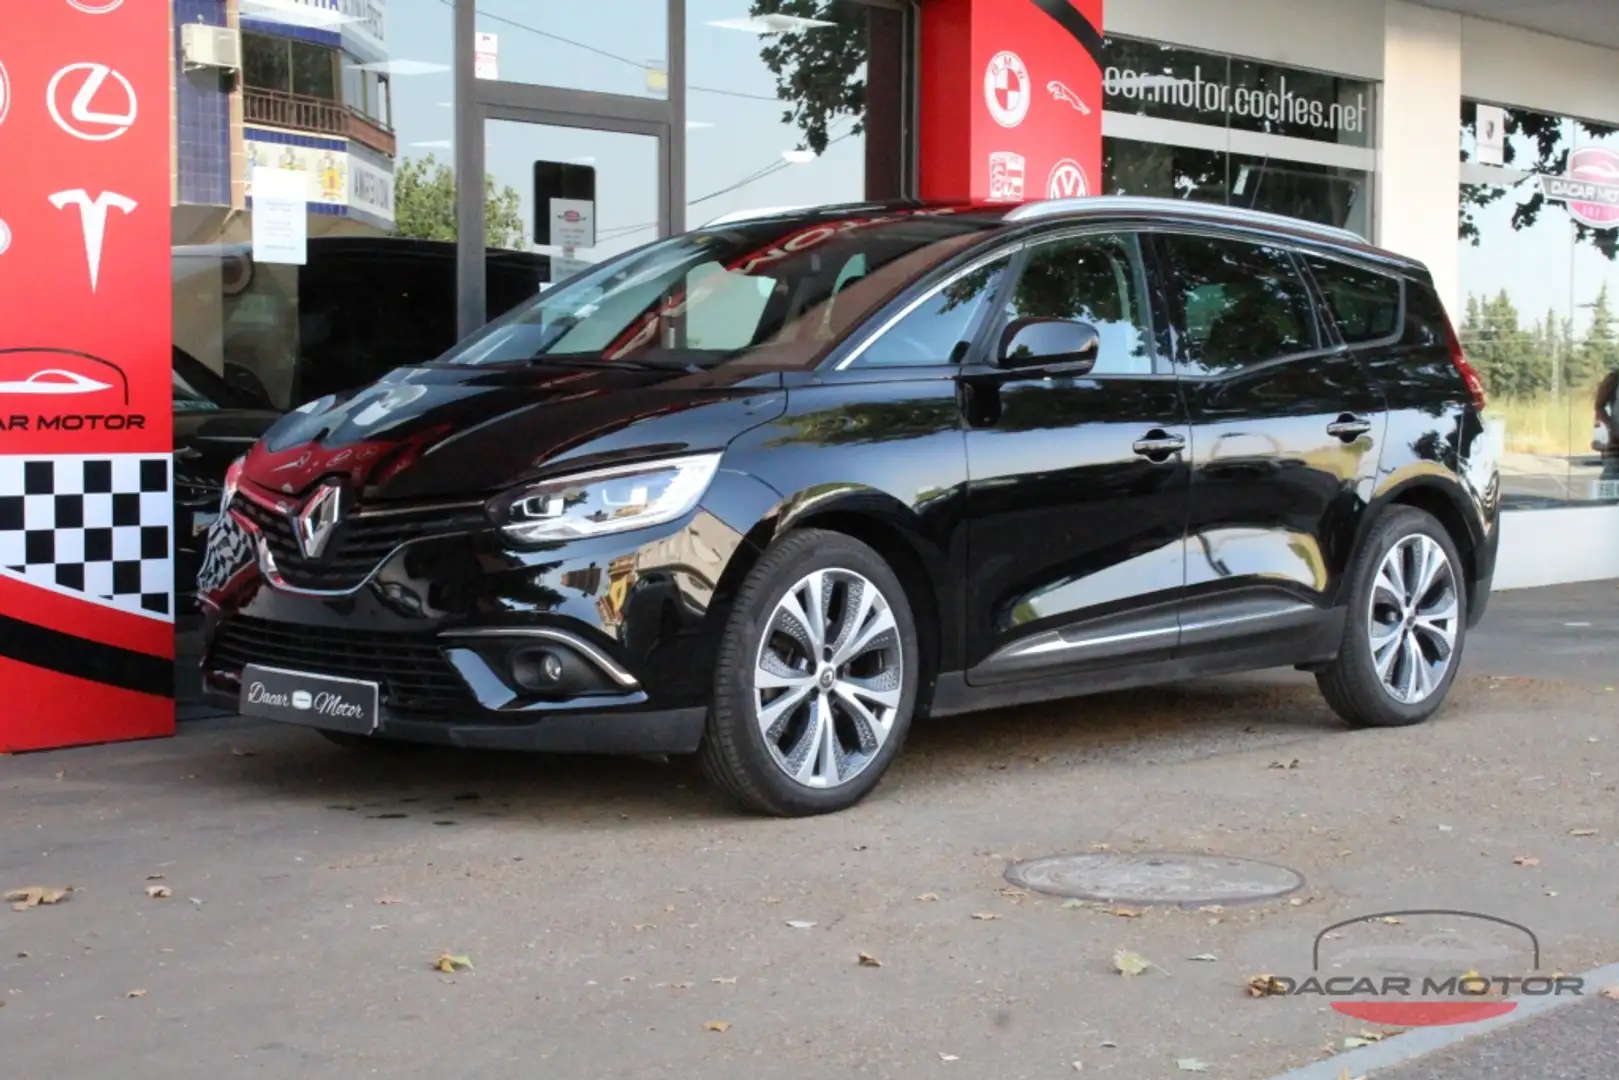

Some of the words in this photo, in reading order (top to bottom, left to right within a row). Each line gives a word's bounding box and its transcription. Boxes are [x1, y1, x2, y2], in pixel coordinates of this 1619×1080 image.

[37, 414, 146, 431] MOTOR
[248, 681, 290, 707] Dacar
[313, 691, 364, 719] Motor
